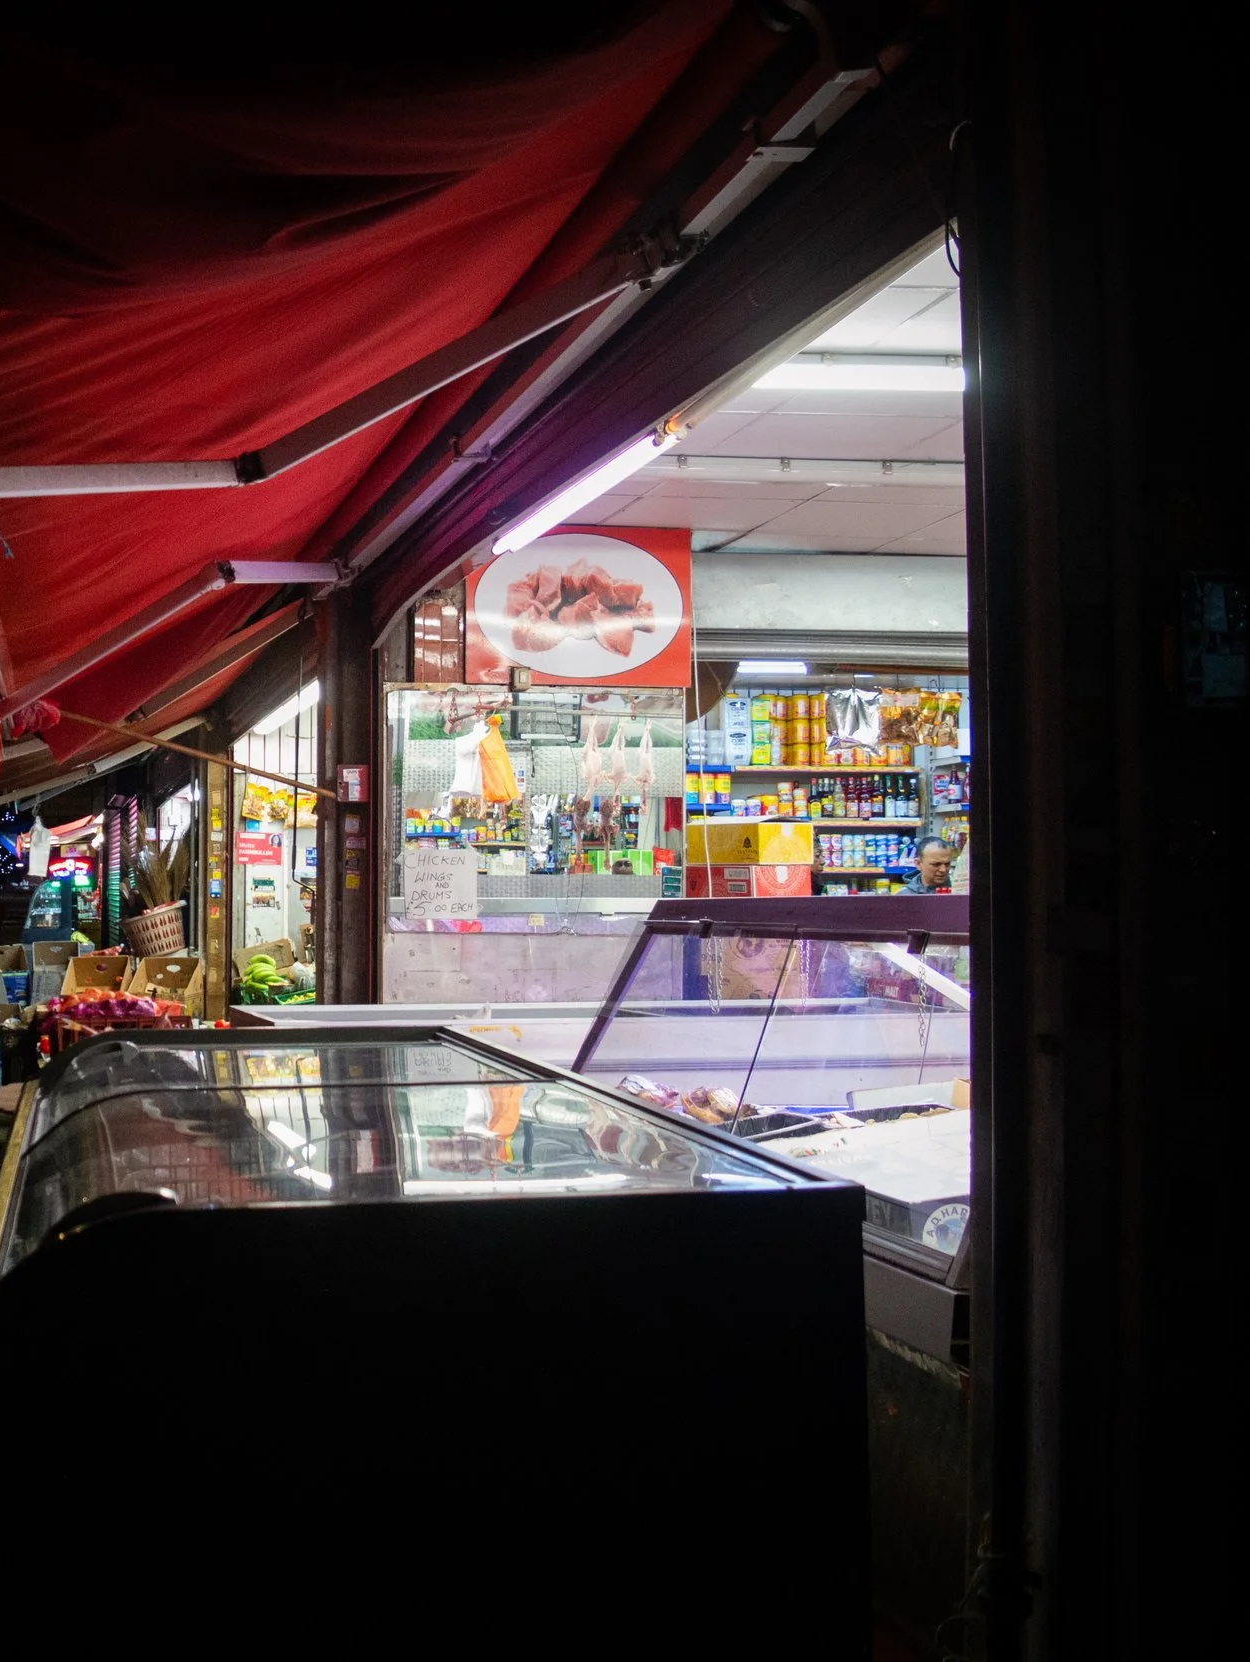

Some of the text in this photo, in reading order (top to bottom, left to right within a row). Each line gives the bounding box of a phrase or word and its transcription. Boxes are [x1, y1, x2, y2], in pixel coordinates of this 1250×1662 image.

[404, 852, 465, 869] CHICKEN
[414, 871, 453, 883] WINGS
[411, 889, 452, 901] DRUMS
[450, 902, 473, 913] EACH
